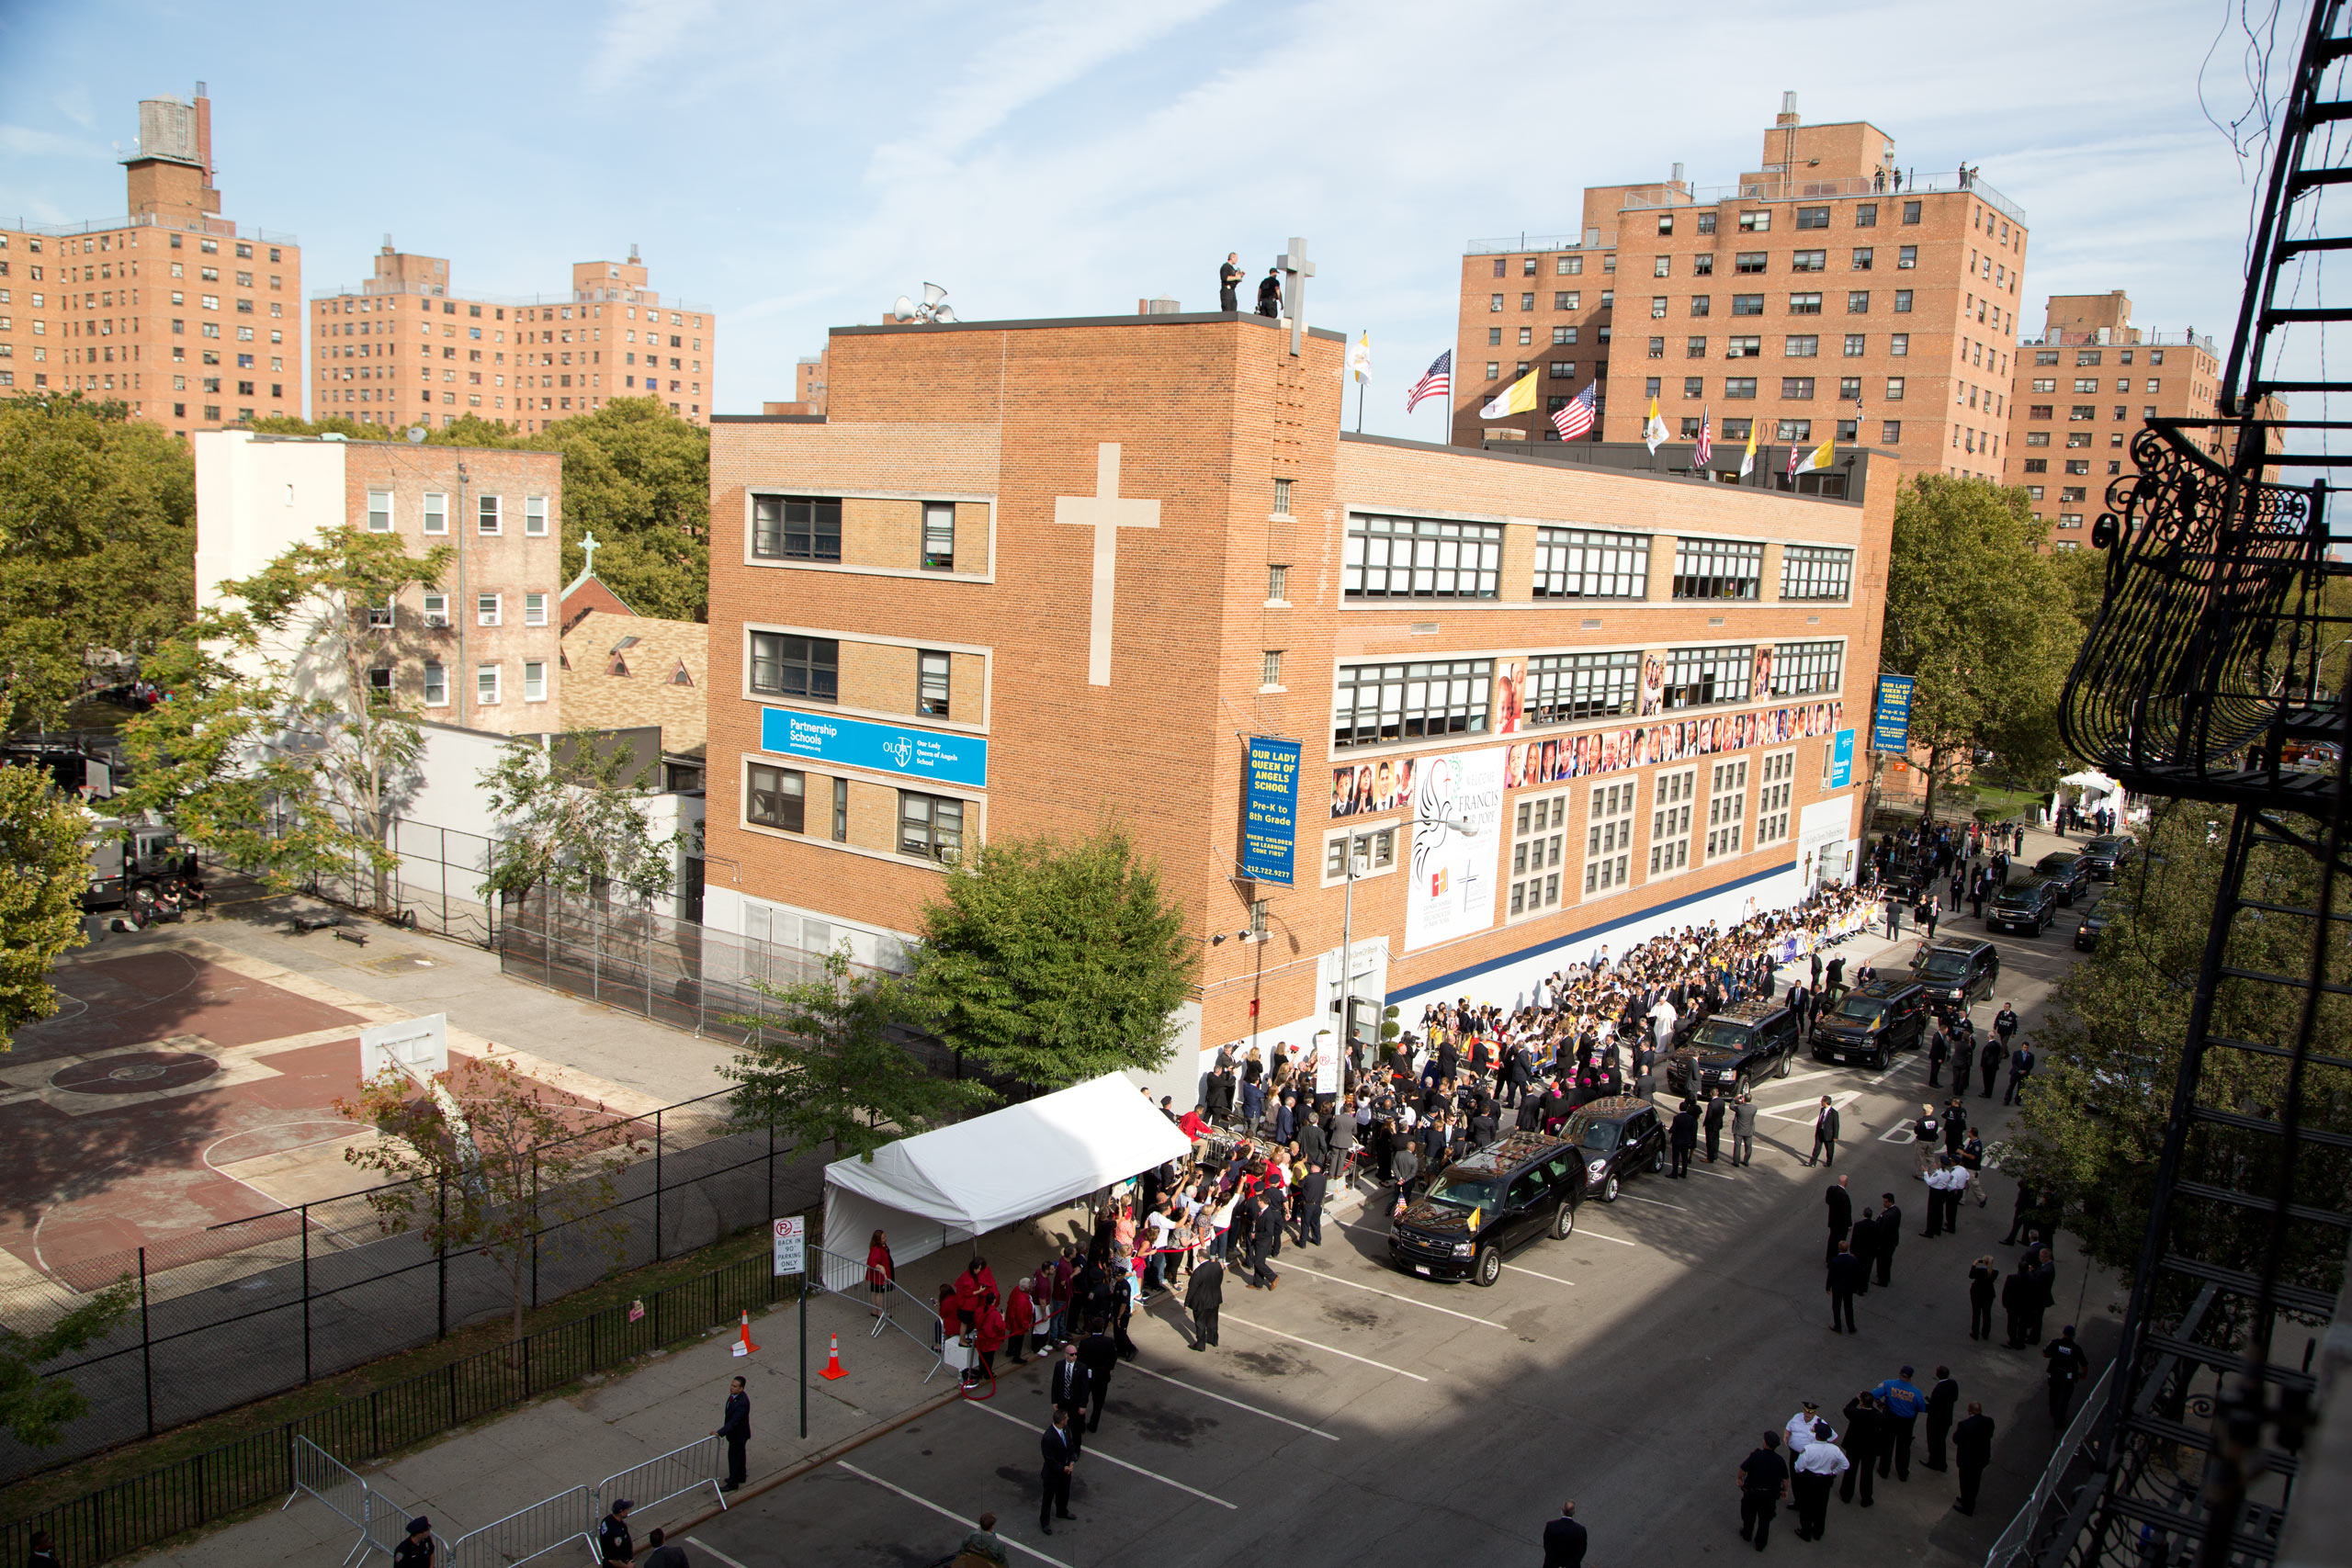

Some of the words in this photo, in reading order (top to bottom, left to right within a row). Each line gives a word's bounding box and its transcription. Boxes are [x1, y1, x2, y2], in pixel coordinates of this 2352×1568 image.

[790, 718, 837, 739] Partnership
[790, 730, 821, 745] Schools
[1252, 750, 1270, 760] OUR
[1272, 752, 1296, 762] LADY
[1251, 760, 1281, 772] QUEEN
[1283, 764, 1295, 773] OF
[1255, 771, 1289, 783] ANGELS
[1255, 781, 1289, 794] SCHOOL
[1253, 801, 1275, 812] Pre-K
[1278, 806, 1287, 814] to
[1459, 790, 1498, 812] FRANCIS
[1250, 812, 1262, 821] 8th
[1265, 815, 1291, 826] Grade
[1478, 811, 1495, 825] POPE
[1261, 842, 1287, 852] LEARNING
[1265, 837, 1293, 846] CHILDREN
[778, 1252, 801, 1260] PARKING
